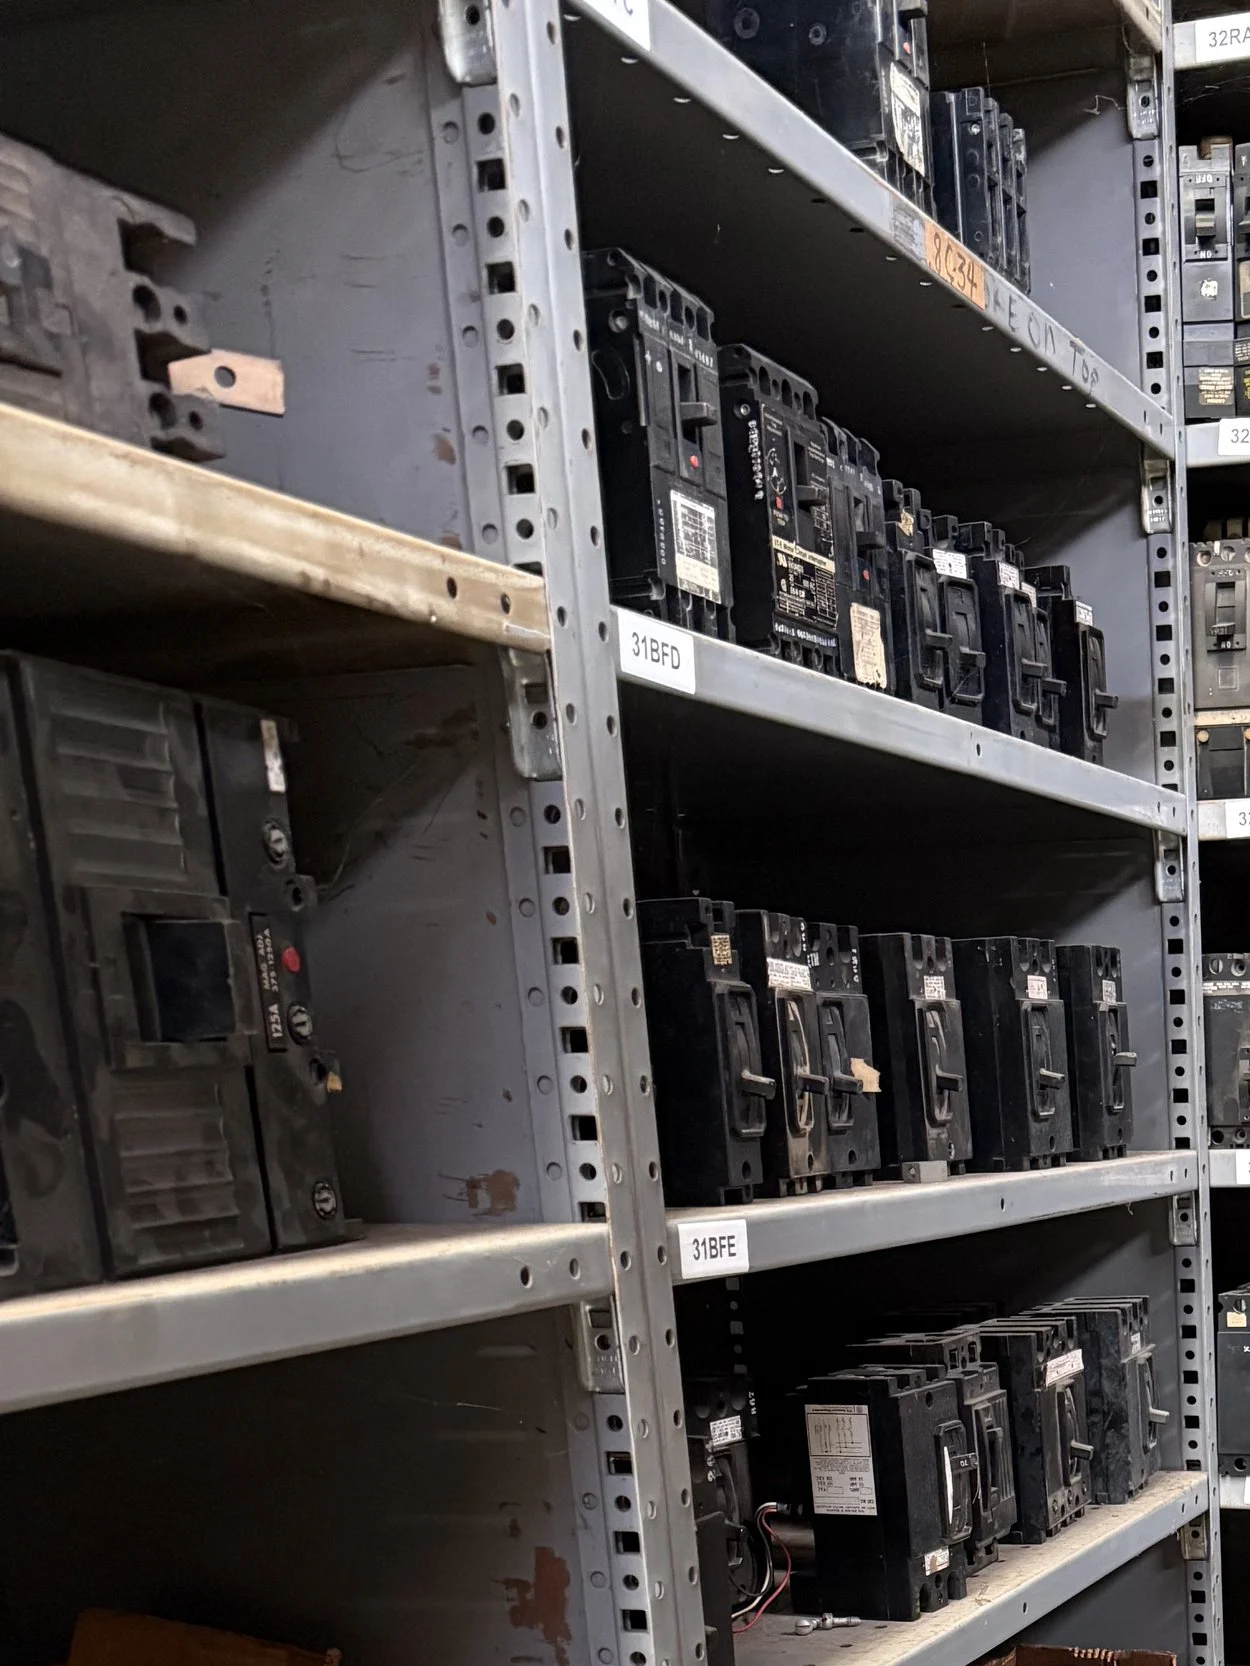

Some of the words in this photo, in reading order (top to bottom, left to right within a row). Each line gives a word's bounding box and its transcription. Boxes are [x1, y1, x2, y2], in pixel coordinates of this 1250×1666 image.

[632, 632, 680, 669] 31BFD
[268, 1003, 283, 1038] 125A
[693, 1235, 736, 1260] 31BFE
